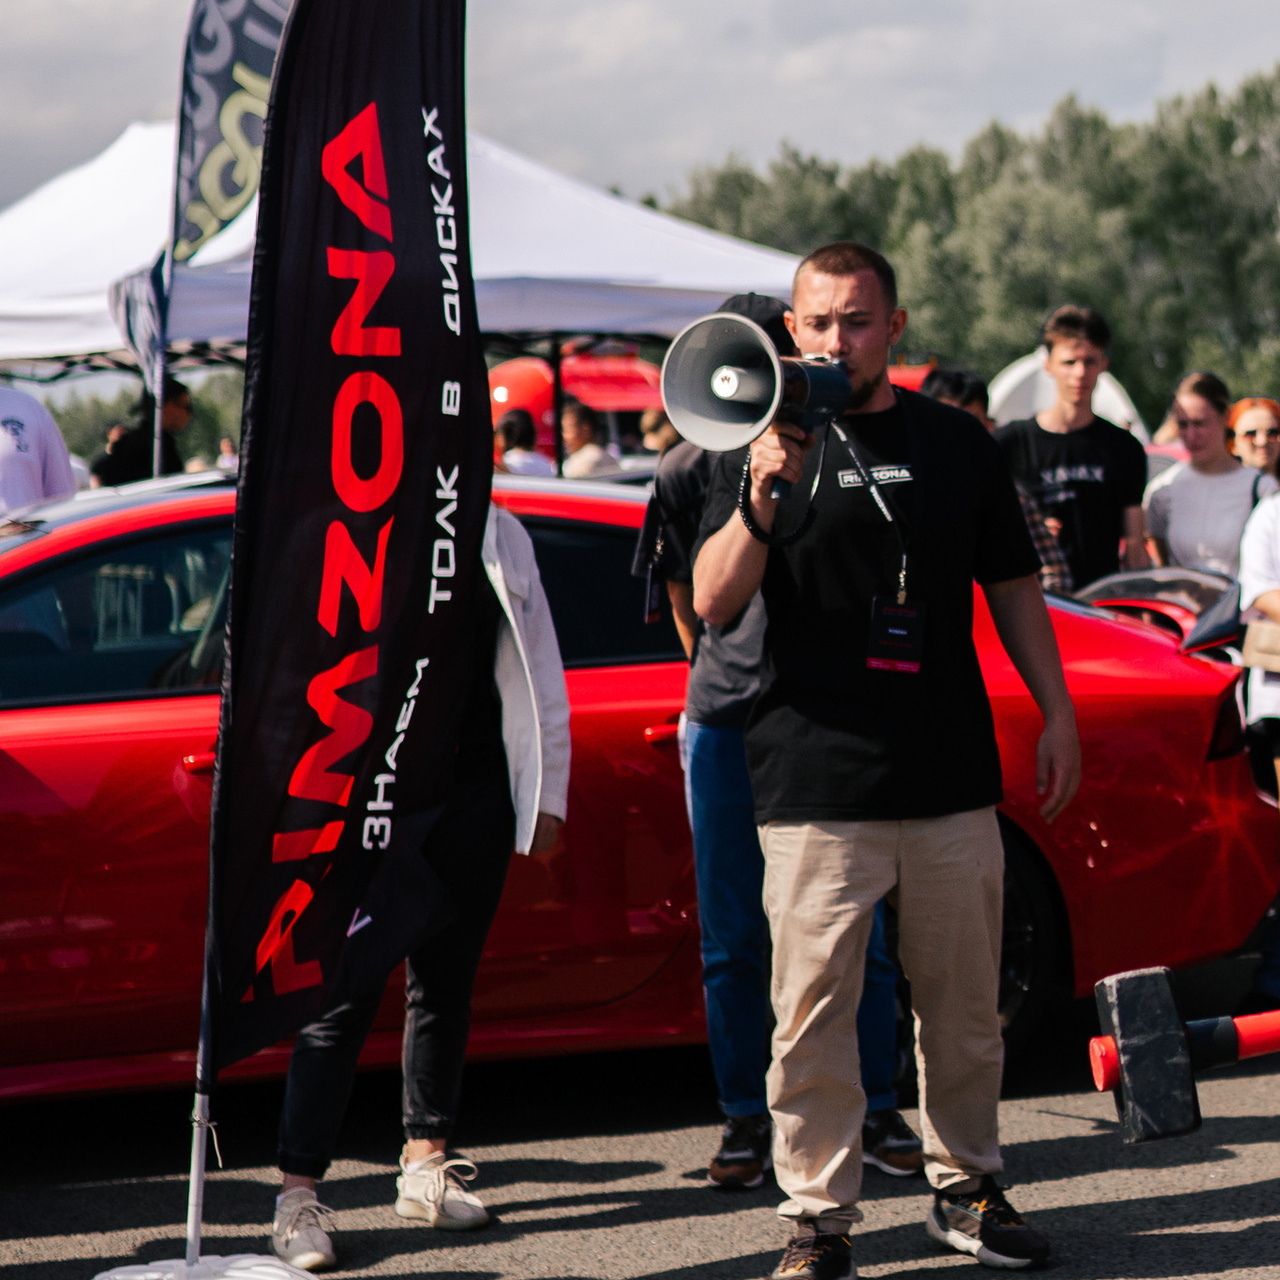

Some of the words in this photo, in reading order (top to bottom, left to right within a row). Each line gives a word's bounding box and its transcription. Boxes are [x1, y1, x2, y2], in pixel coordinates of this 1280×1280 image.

[420, 106, 462, 336] ДИСКАХ
[441, 380, 461, 416] В
[428, 464, 460, 613] ТОЛК
[843, 469, 911, 484] RIZONA
[241, 101, 402, 1003] RIMZONA
